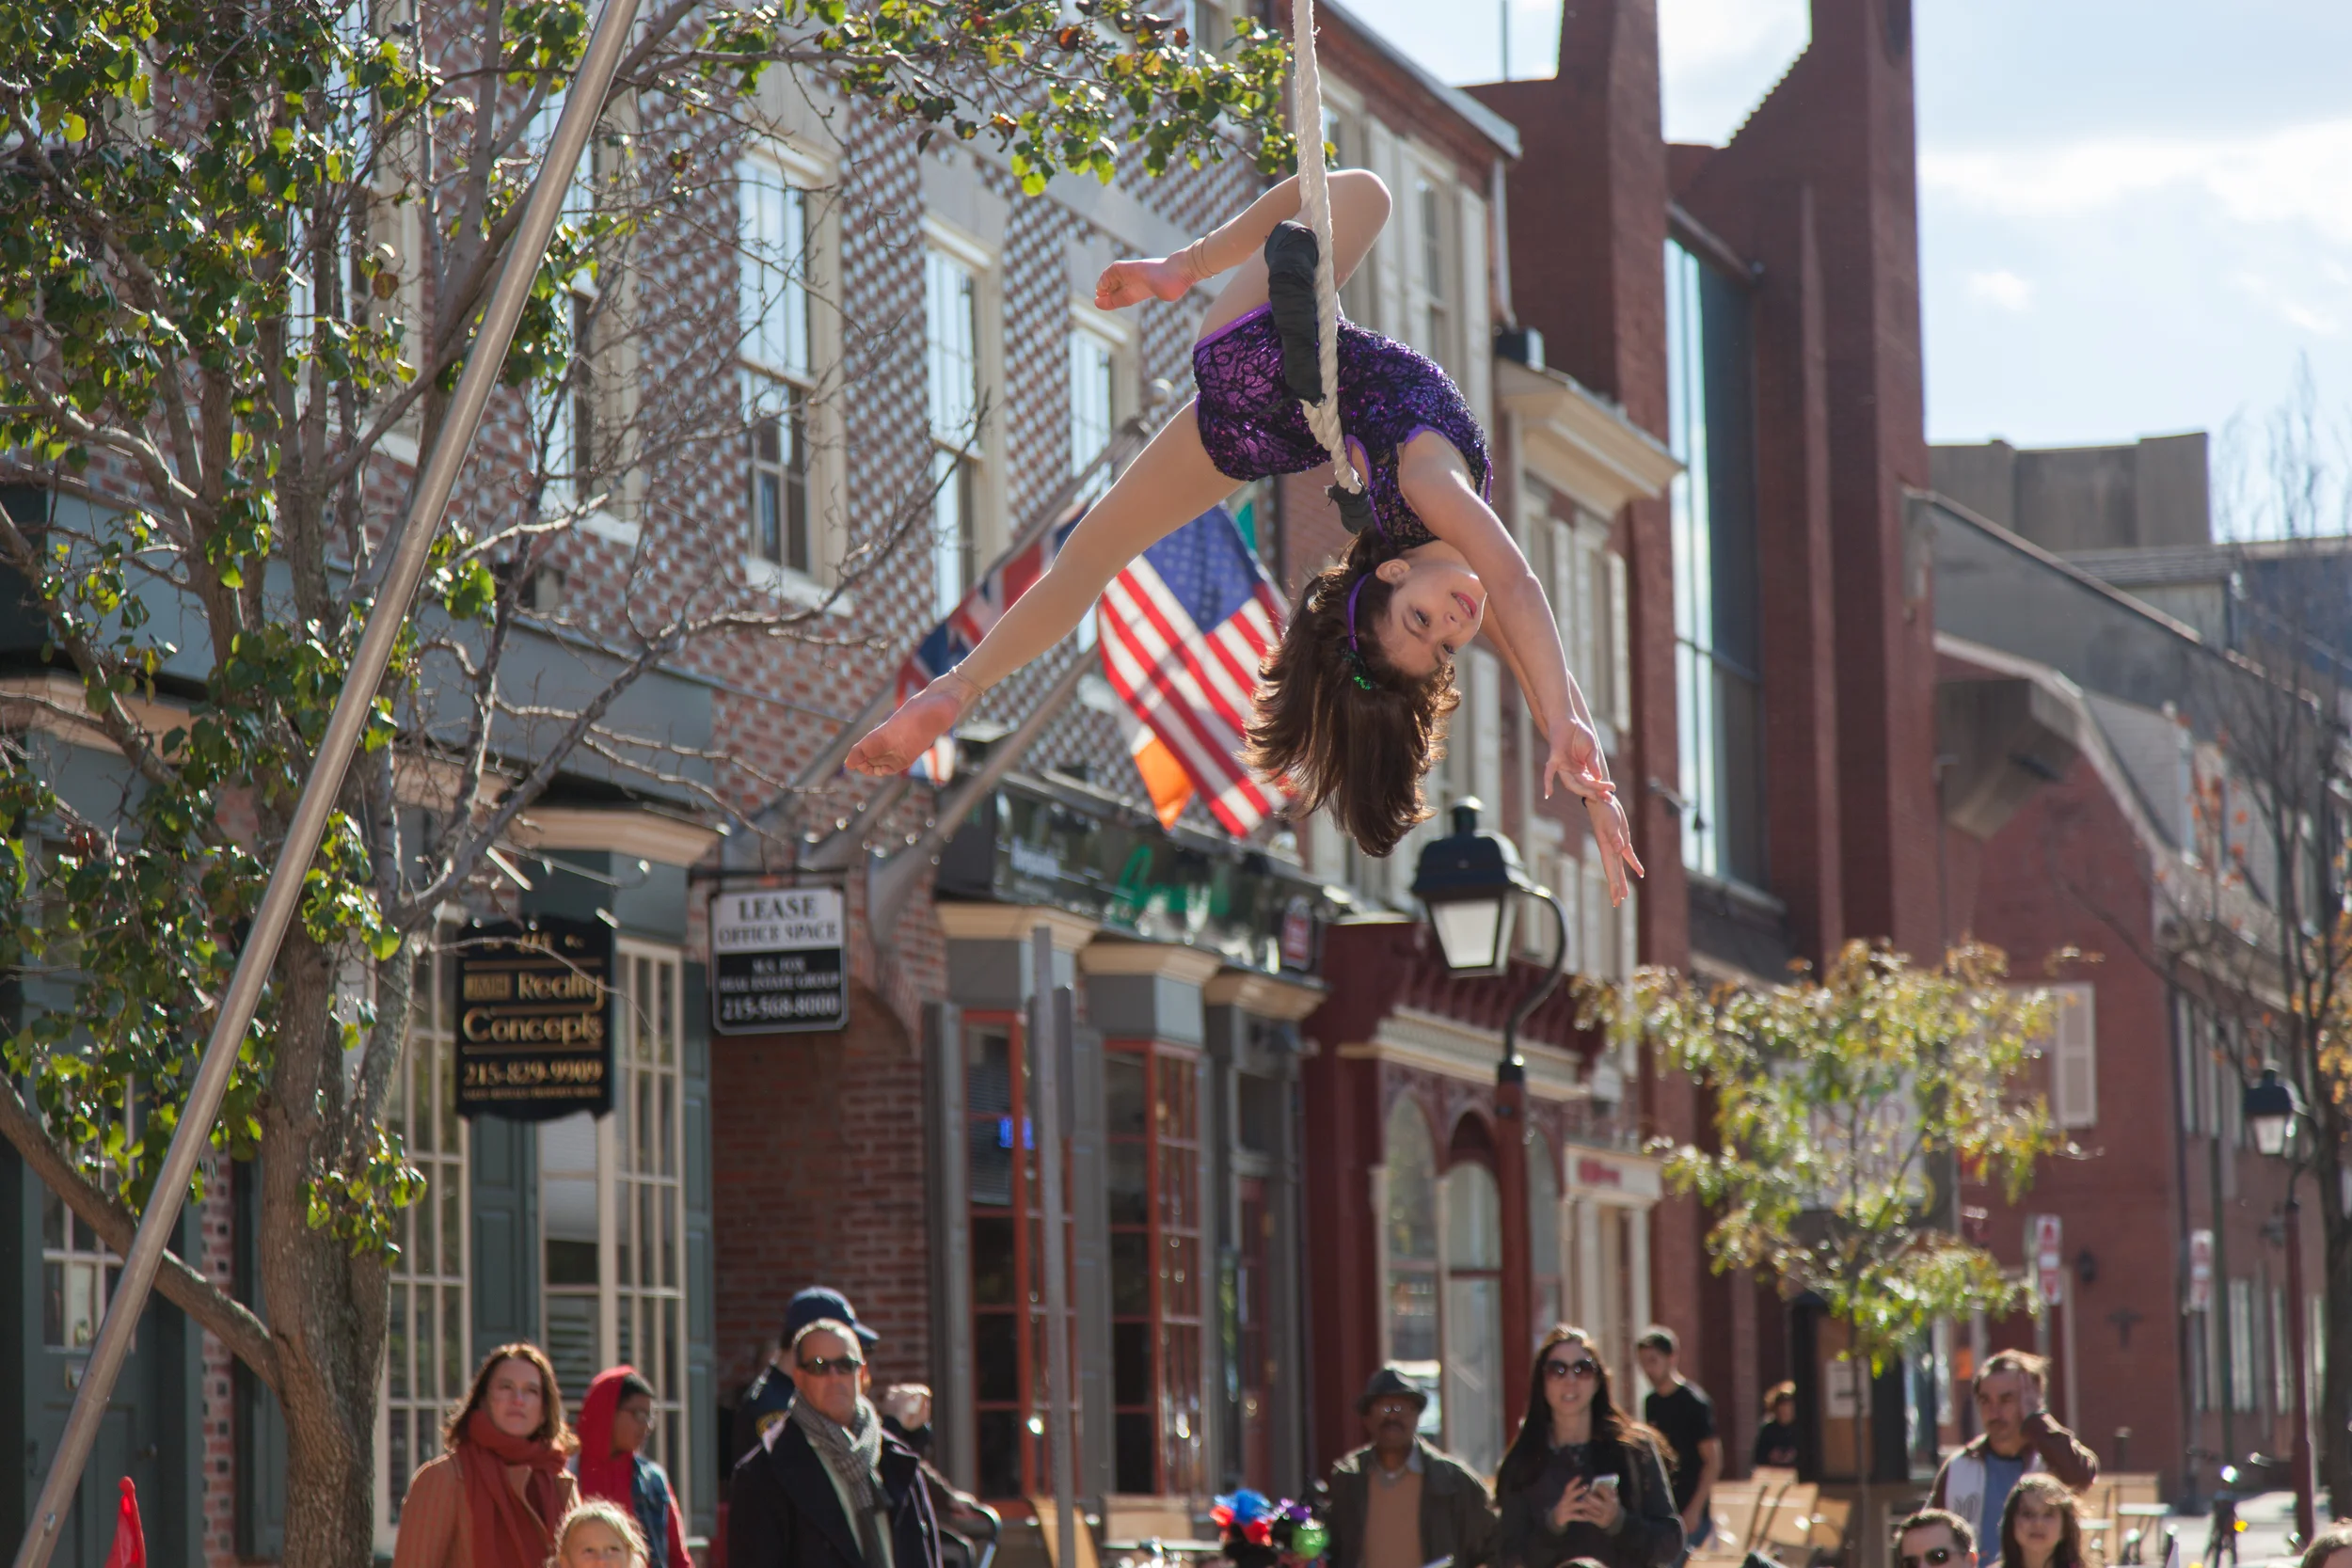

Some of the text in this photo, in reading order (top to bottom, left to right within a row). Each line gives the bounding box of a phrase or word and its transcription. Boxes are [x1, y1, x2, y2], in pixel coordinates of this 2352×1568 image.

[739, 895, 818, 921] LEASE
[719, 921, 836, 945] OFFICE SPACE
[720, 972, 839, 992] REAL ESTATE GROUP
[722, 993, 840, 1021] 215-568-8000
[463, 1006, 604, 1046] Concepts
[464, 1058, 603, 1085] 215-829-9909
